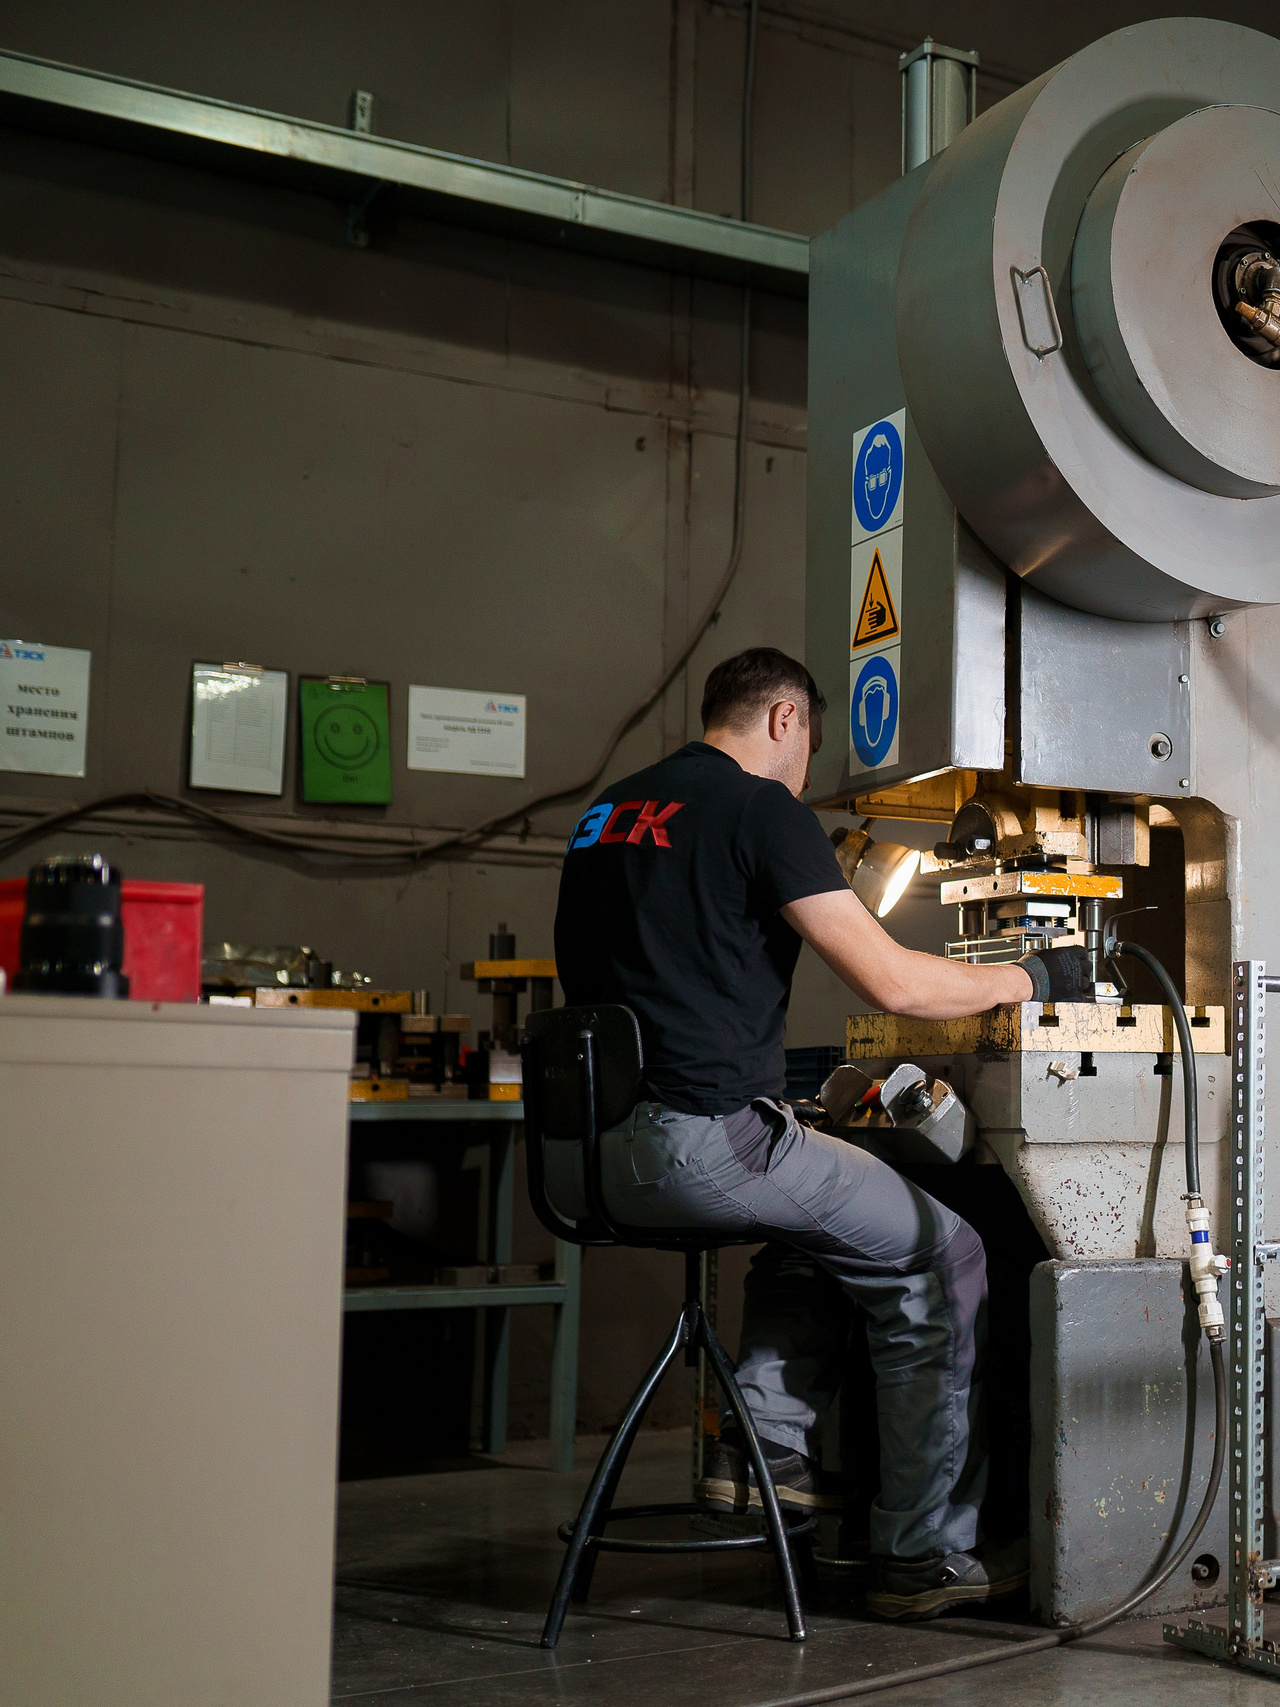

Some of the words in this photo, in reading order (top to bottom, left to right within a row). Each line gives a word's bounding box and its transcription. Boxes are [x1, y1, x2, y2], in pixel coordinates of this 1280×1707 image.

[18, 684, 60, 697] место
[7, 704, 78, 720] хранения
[6, 726, 75, 741] штампов
